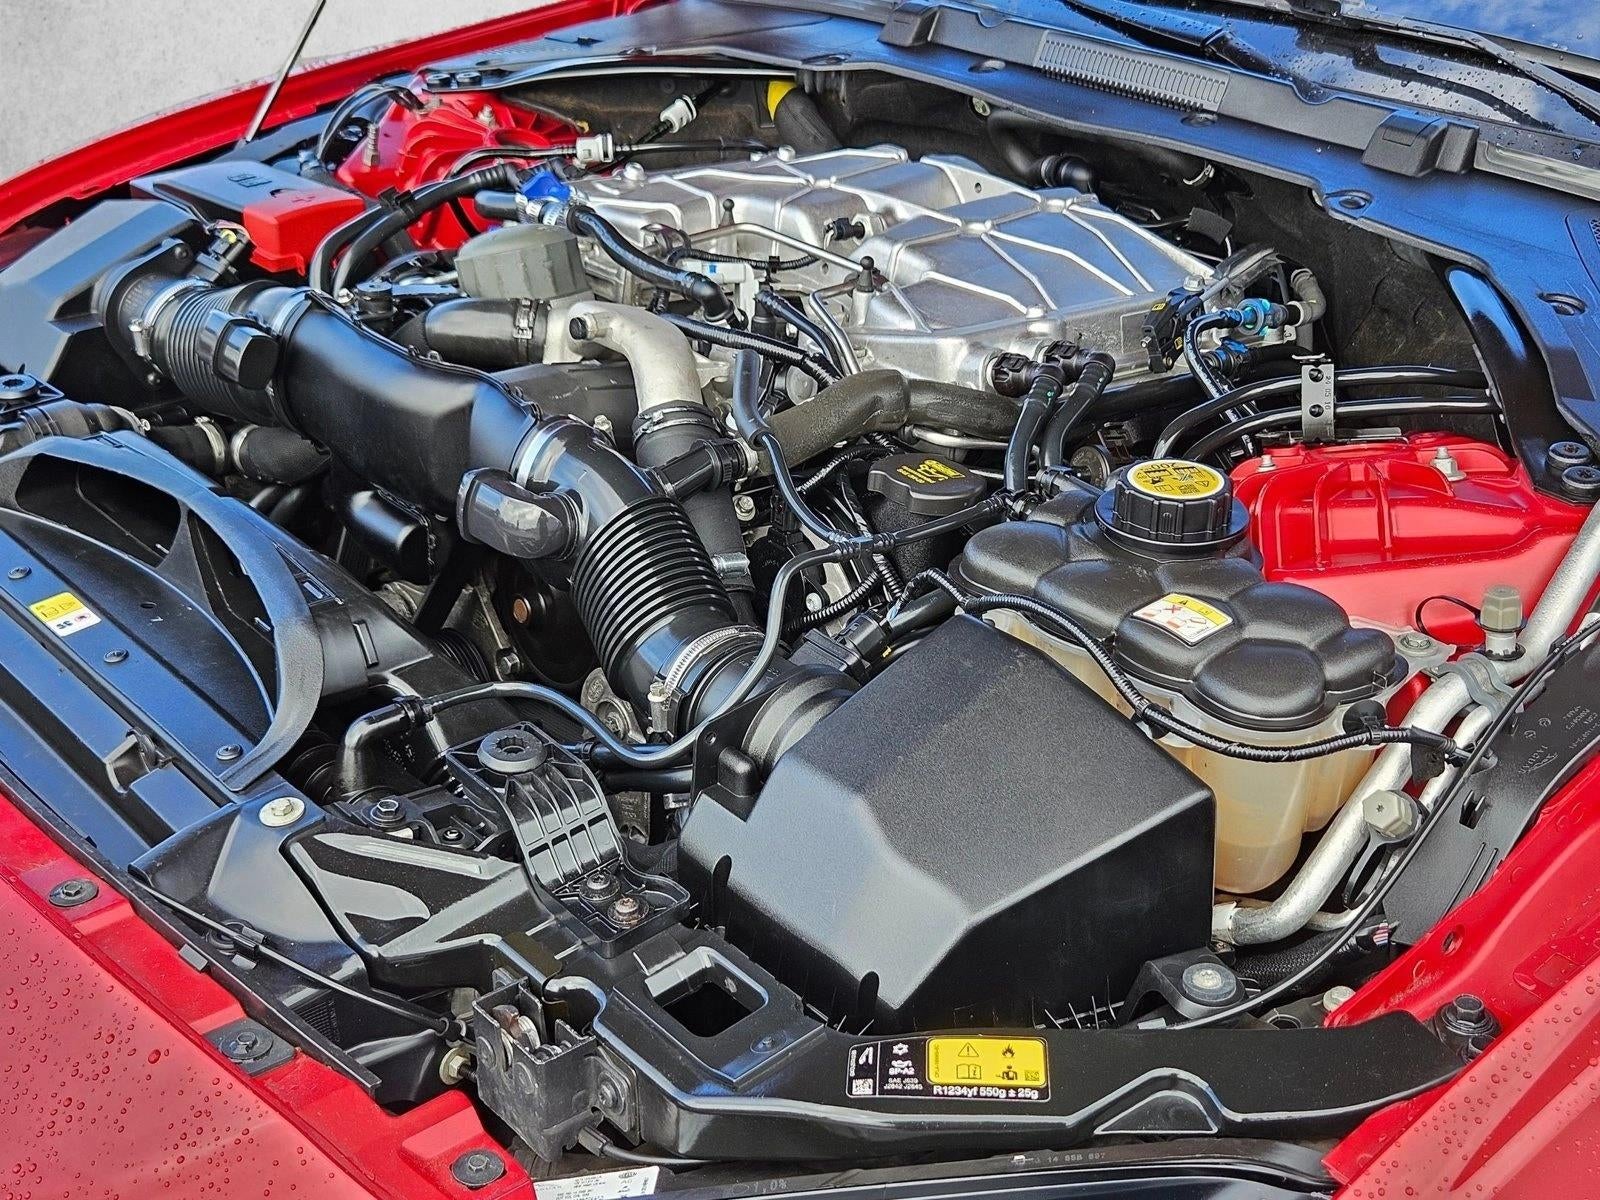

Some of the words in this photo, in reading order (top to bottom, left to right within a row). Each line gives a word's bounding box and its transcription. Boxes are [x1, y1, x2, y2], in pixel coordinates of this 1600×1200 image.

[933, 1085, 978, 1098] R1234yf
[980, 1086, 1007, 1099] 550g
[1018, 1088, 1039, 1100] 25g
